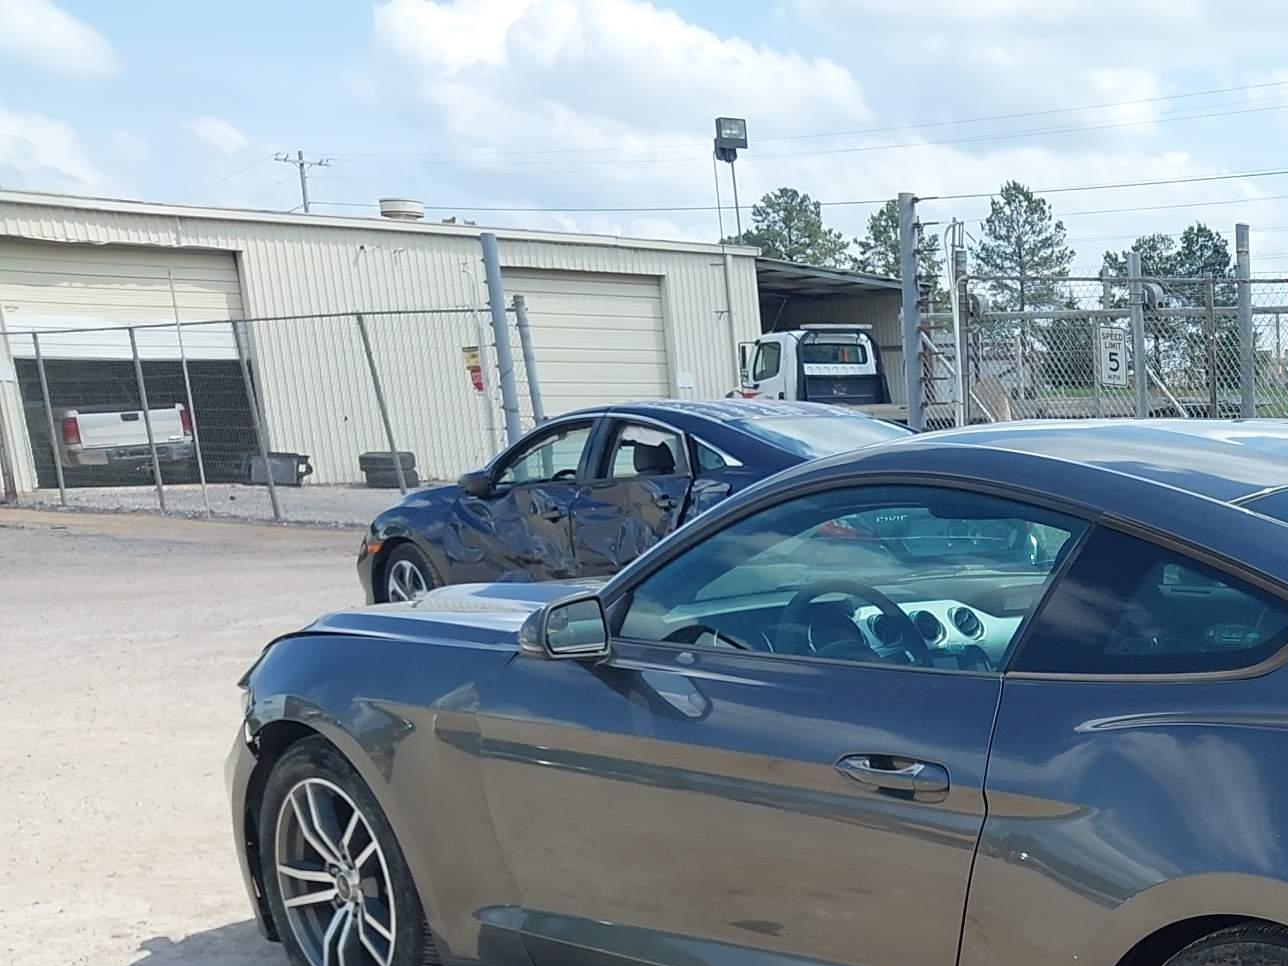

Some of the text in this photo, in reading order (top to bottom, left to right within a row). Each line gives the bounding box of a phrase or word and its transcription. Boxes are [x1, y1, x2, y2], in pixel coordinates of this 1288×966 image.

[1101, 332, 1122, 341] SPEED
[1104, 341, 1121, 350] LIMIT
[1108, 351, 1120, 372] 5
